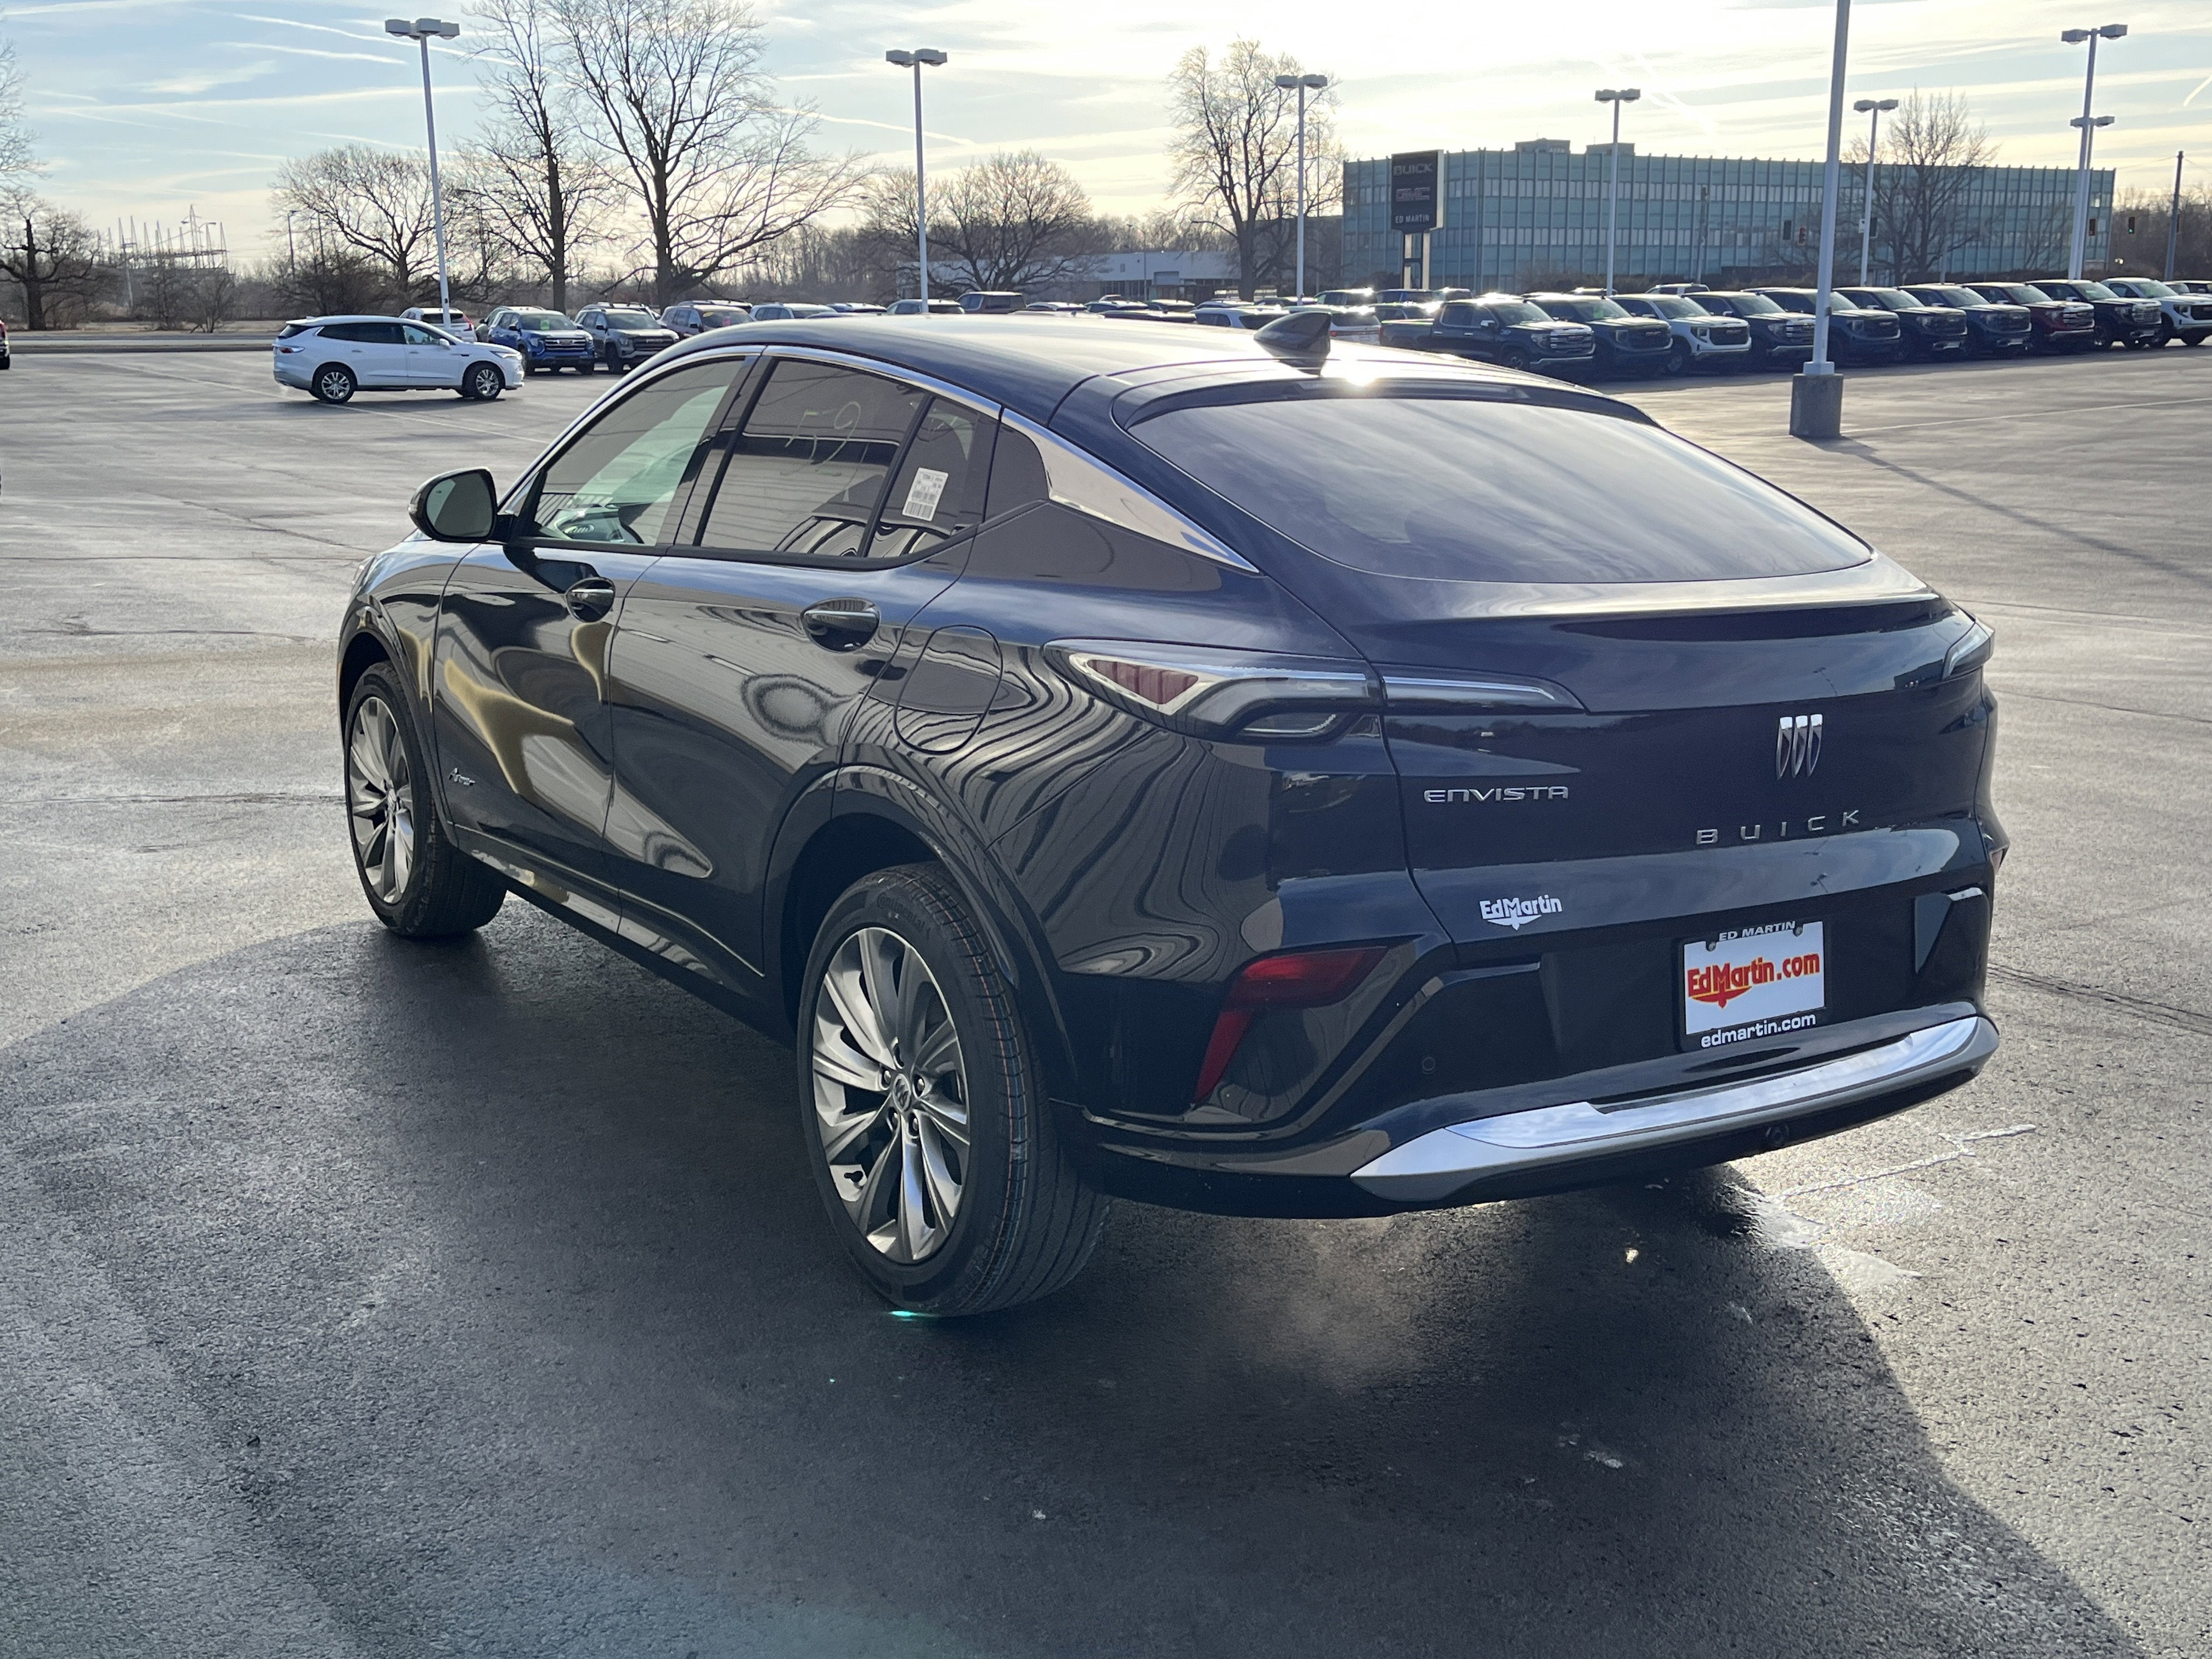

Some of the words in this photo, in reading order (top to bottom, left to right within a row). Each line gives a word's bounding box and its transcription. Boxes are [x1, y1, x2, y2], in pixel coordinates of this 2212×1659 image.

[1393, 163, 1433, 176] BUICK
[1395, 187, 1431, 202] GMC
[1395, 215, 1402, 224] ED
[1406, 213, 1430, 223] MARTIN
[1424, 785, 1569, 803] ENVISTA
[1696, 809, 1860, 845] BUICK
[1719, 931, 1738, 942] ED
[1741, 920, 1796, 938] MARTIN
[1701, 1014, 1816, 1048] edmartin.com
